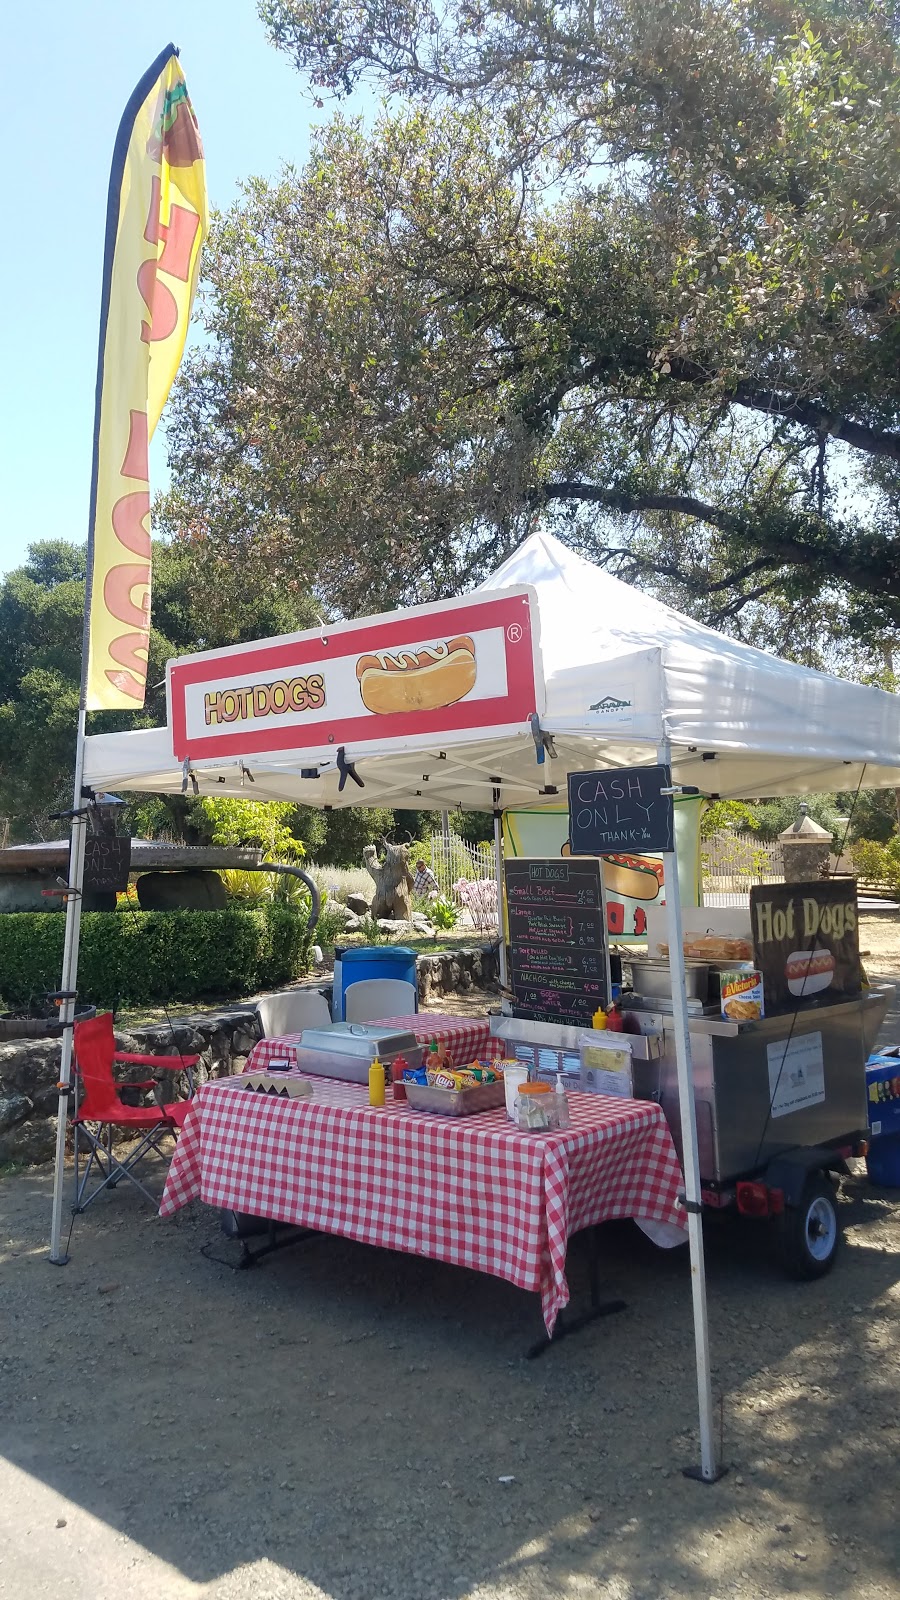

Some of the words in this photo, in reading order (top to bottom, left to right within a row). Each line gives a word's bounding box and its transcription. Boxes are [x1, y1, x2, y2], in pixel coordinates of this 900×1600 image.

[577, 777, 643, 803] CASH
[576, 801, 655, 829] ONLY
[531, 867, 543, 878] HOT
[545, 867, 565, 879] DOGS
[513, 885, 533, 896] Small
[536, 885, 556, 896] Beef
[755, 897, 796, 944] Hot
[802, 897, 857, 941] Dogs
[520, 973, 548, 984] NACHOS
